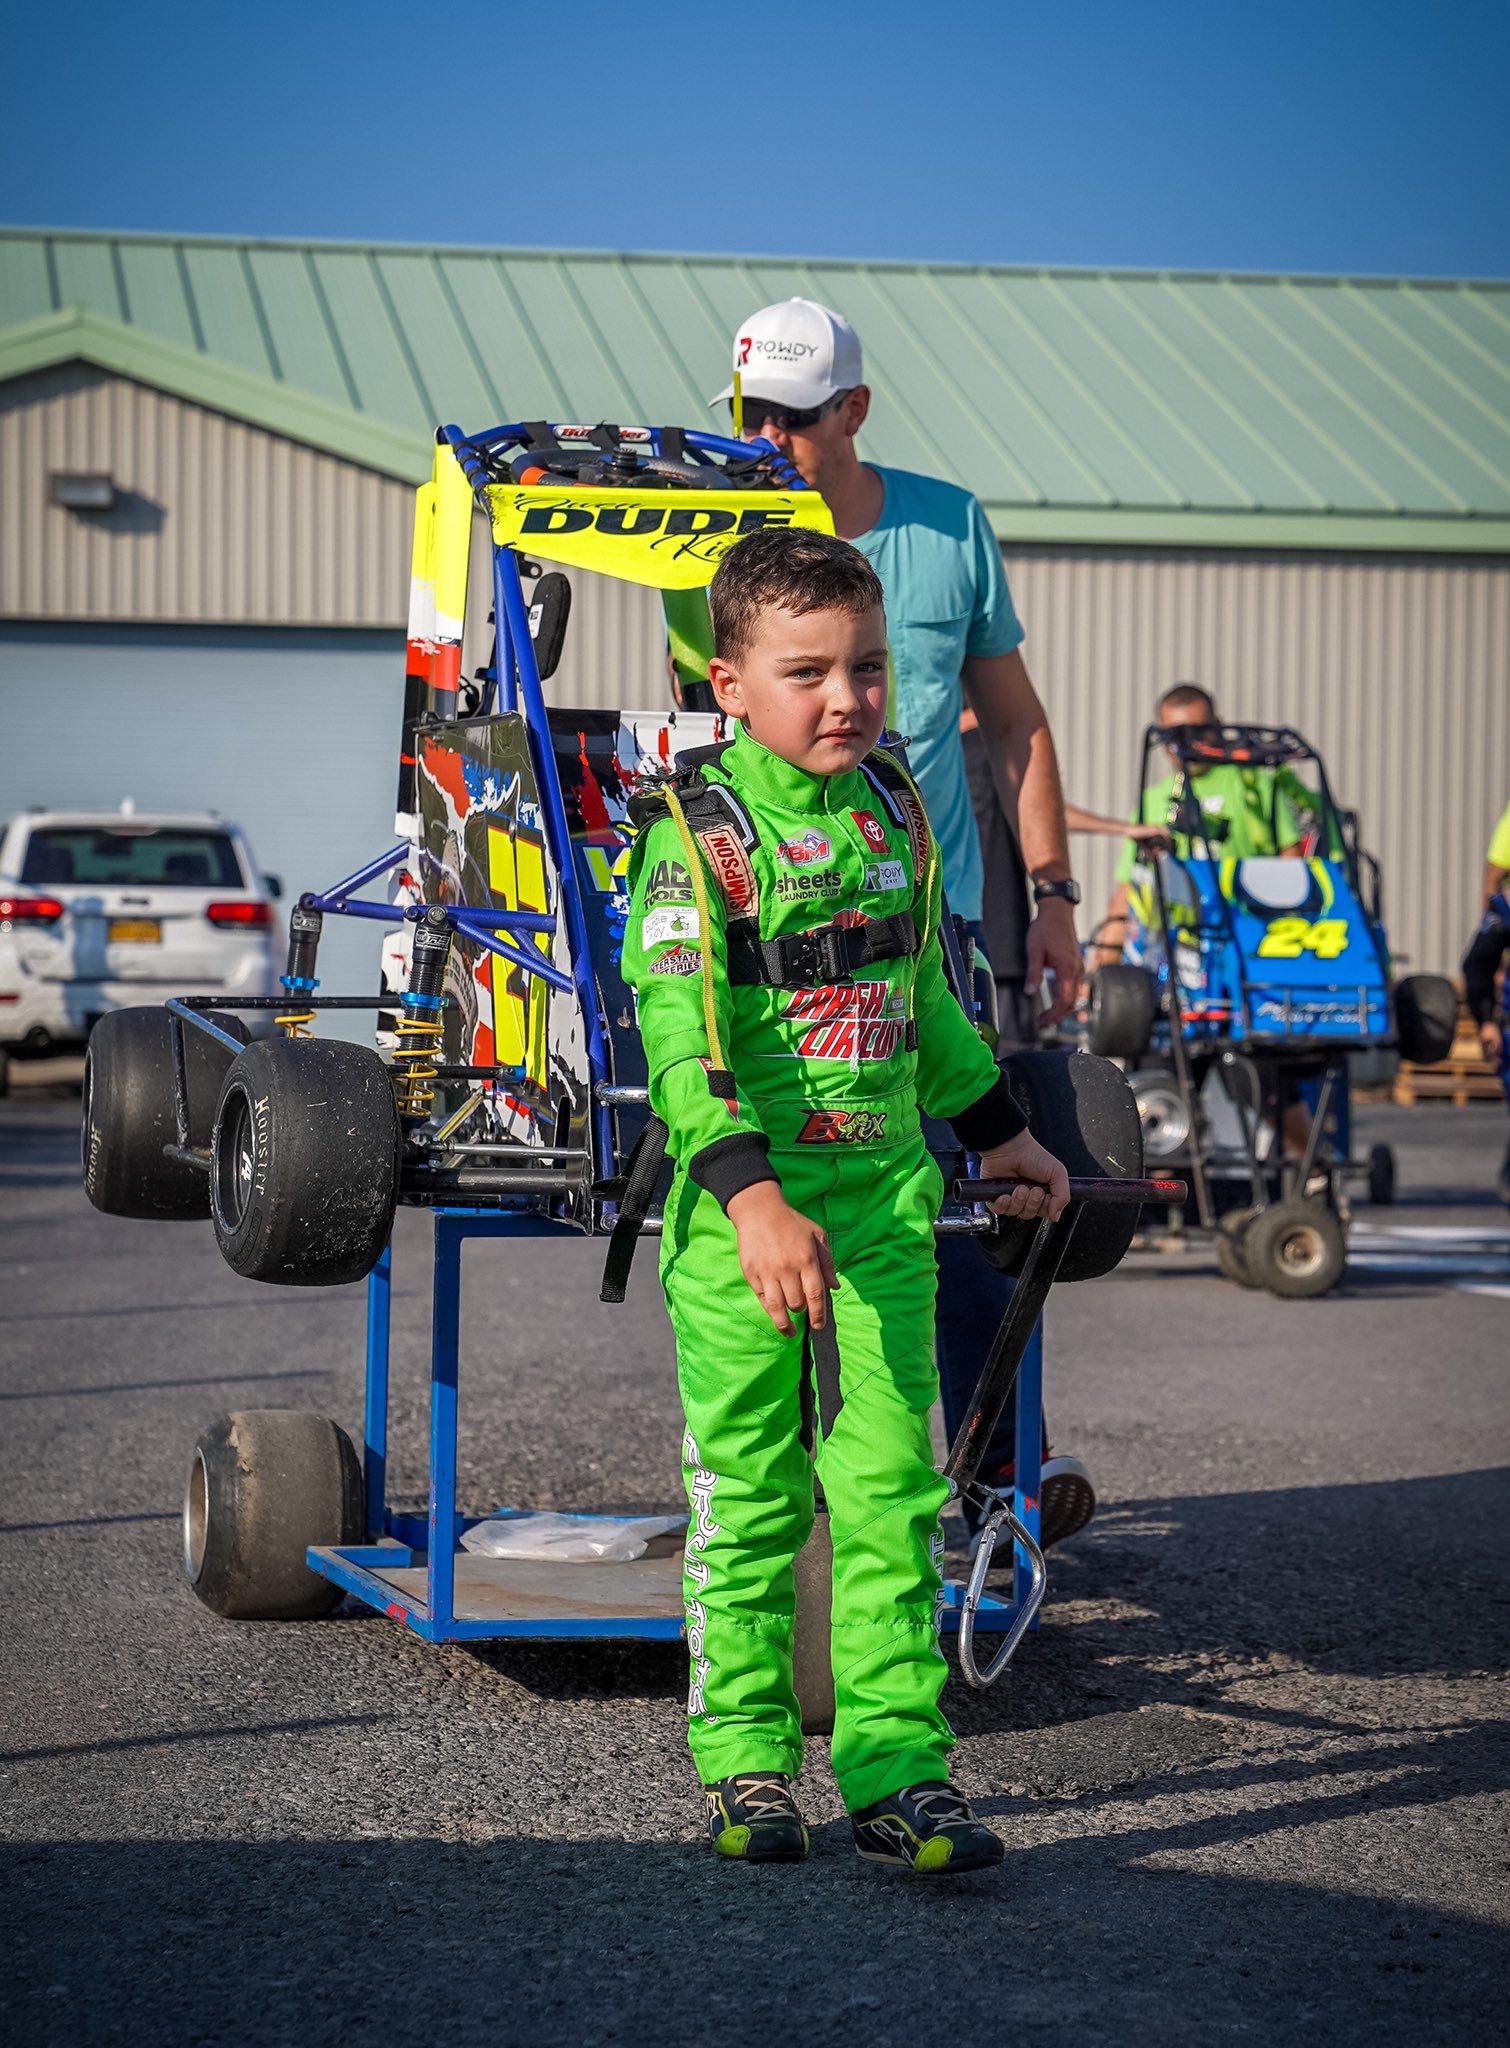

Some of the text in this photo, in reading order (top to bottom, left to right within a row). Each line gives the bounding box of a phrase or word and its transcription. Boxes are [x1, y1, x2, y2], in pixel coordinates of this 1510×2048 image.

[756, 340, 819, 358] ROWDY
[519, 508, 796, 535] DUDE
[644, 860, 693, 900] MAC
[711, 836, 748, 910] SIMPSON
[775, 869, 842, 894] sheets
[643, 889, 693, 911] TOOLS
[780, 888, 839, 902] LAUNDRY CLUB
[1257, 917, 1348, 958] 24
[779, 980, 888, 1020] CRASH
